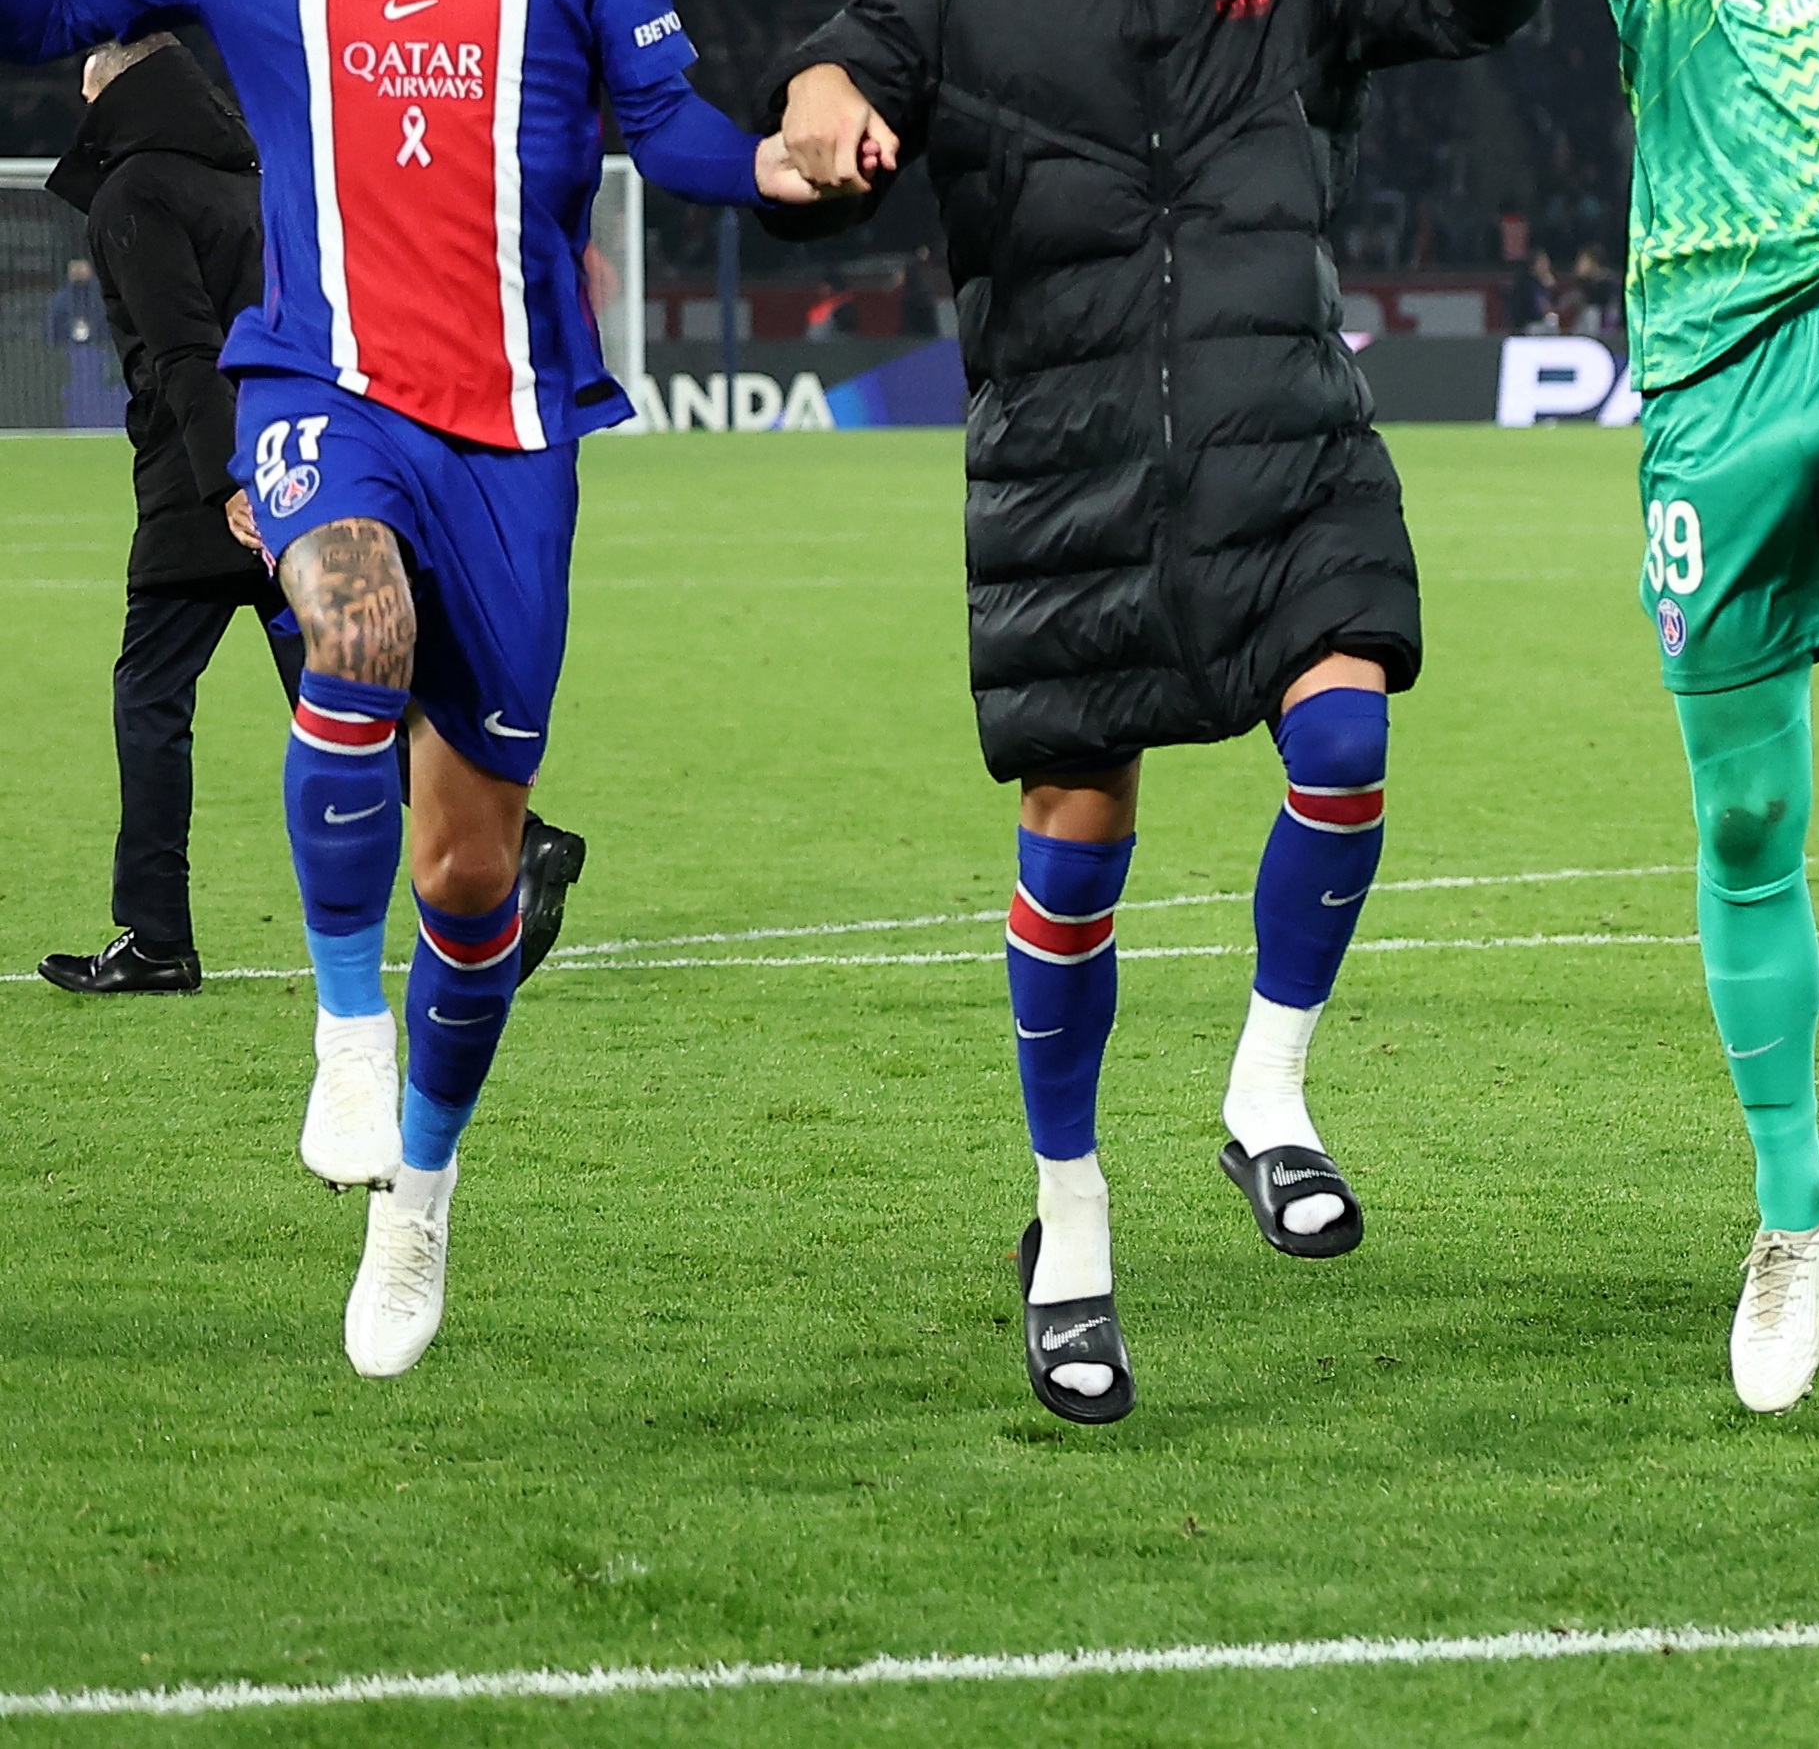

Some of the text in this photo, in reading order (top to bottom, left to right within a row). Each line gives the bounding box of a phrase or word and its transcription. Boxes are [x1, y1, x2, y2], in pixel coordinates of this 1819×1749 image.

[343, 41, 485, 82] QATAR
[378, 76, 485, 101] AIRWAYS
[1647, 498, 1705, 596] 39
